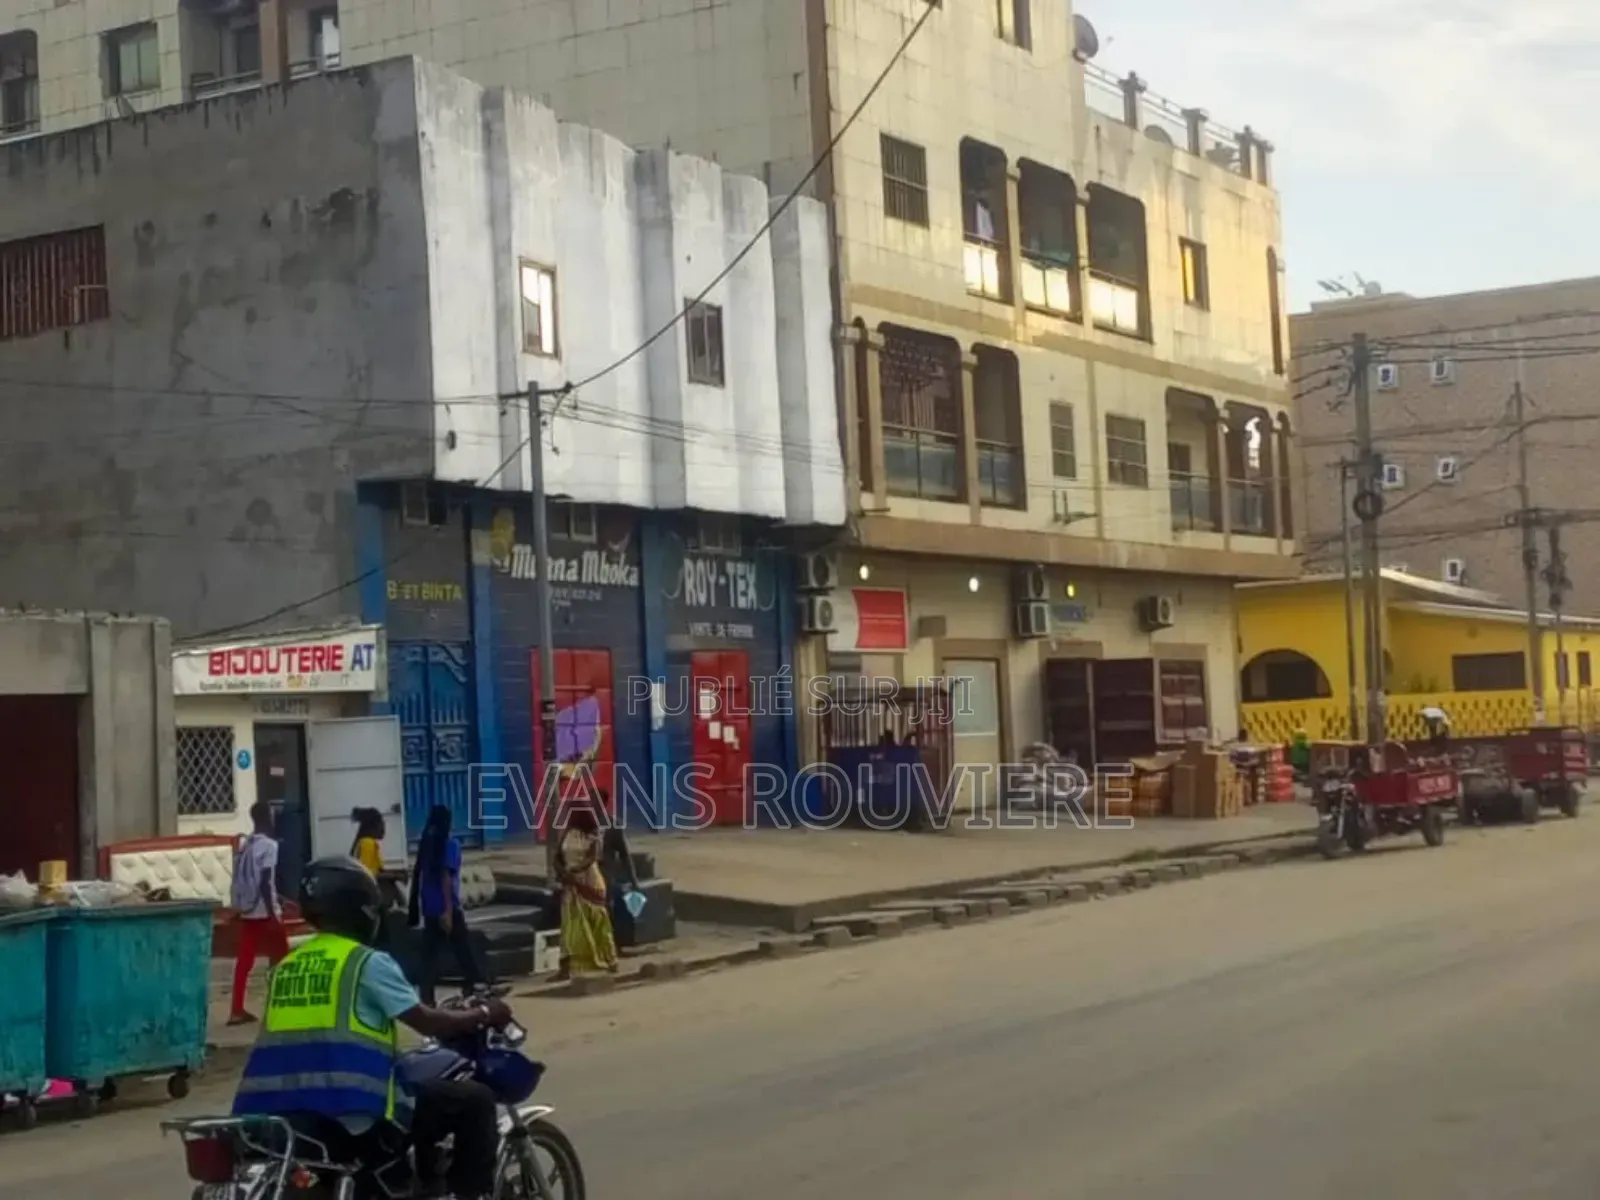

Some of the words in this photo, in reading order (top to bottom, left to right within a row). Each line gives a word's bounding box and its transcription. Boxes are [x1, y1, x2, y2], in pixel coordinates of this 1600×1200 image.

[581, 550, 640, 587] Mboka
[684, 558, 757, 610] ROY-TEX
[208, 645, 344, 676] BIJOUTERIE
[351, 643, 375, 671] AT
